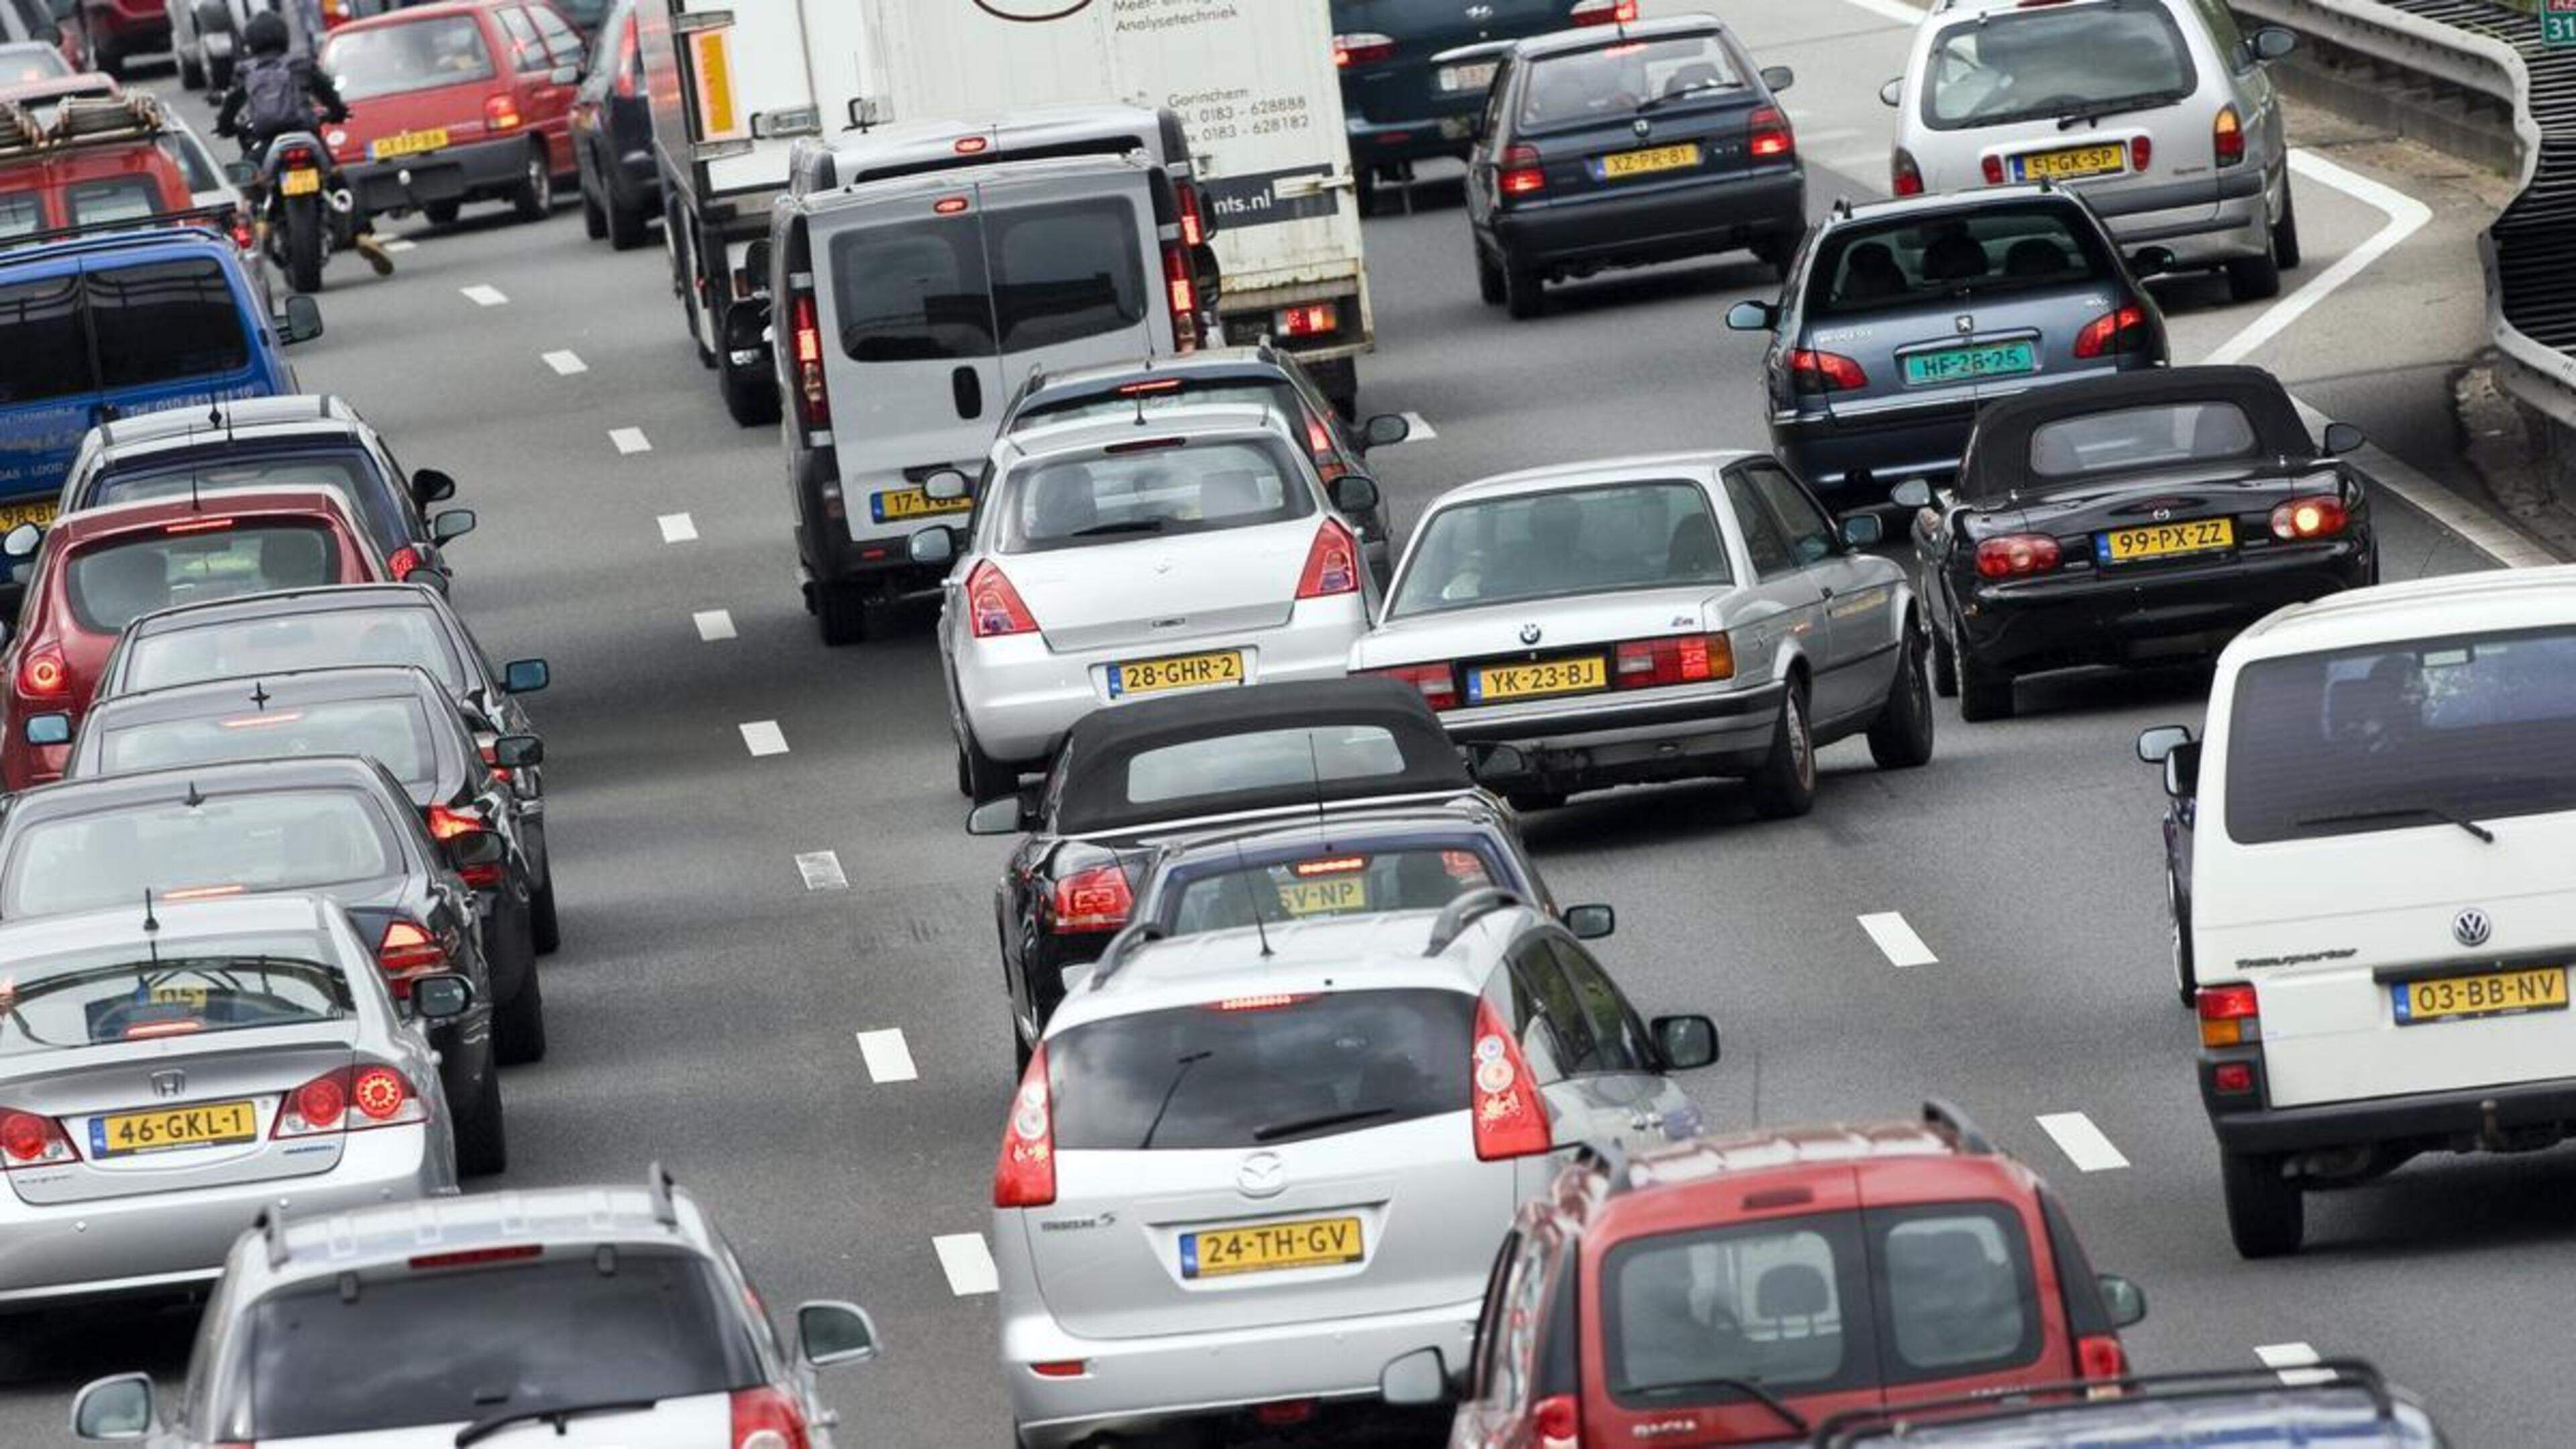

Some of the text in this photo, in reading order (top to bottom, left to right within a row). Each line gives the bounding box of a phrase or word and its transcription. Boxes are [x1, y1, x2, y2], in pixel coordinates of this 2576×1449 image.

[1115, 3, 1238, 32] Analysetechniek
[1167, 88, 1249, 108] Gorinchem
[1199, 105, 1233, 122] 0183
[1250, 95, 1306, 115] 628888
[1201, 124, 1237, 142] 0183
[1252, 115, 1309, 135] 628182
[1613, 147, 1690, 173] XZ-PR-81
[2120, 523, 2224, 554] 99-PX-ZZ
[1127, 656, 1235, 688] 28-GHR-2
[1491, 662, 1595, 694] YK-23-BJ
[2418, 973, 2555, 1012] 03-BB-NV
[119, 1109, 243, 1144] 46-GKL-1
[1208, 1224, 1347, 1263] 24-TH-GV
